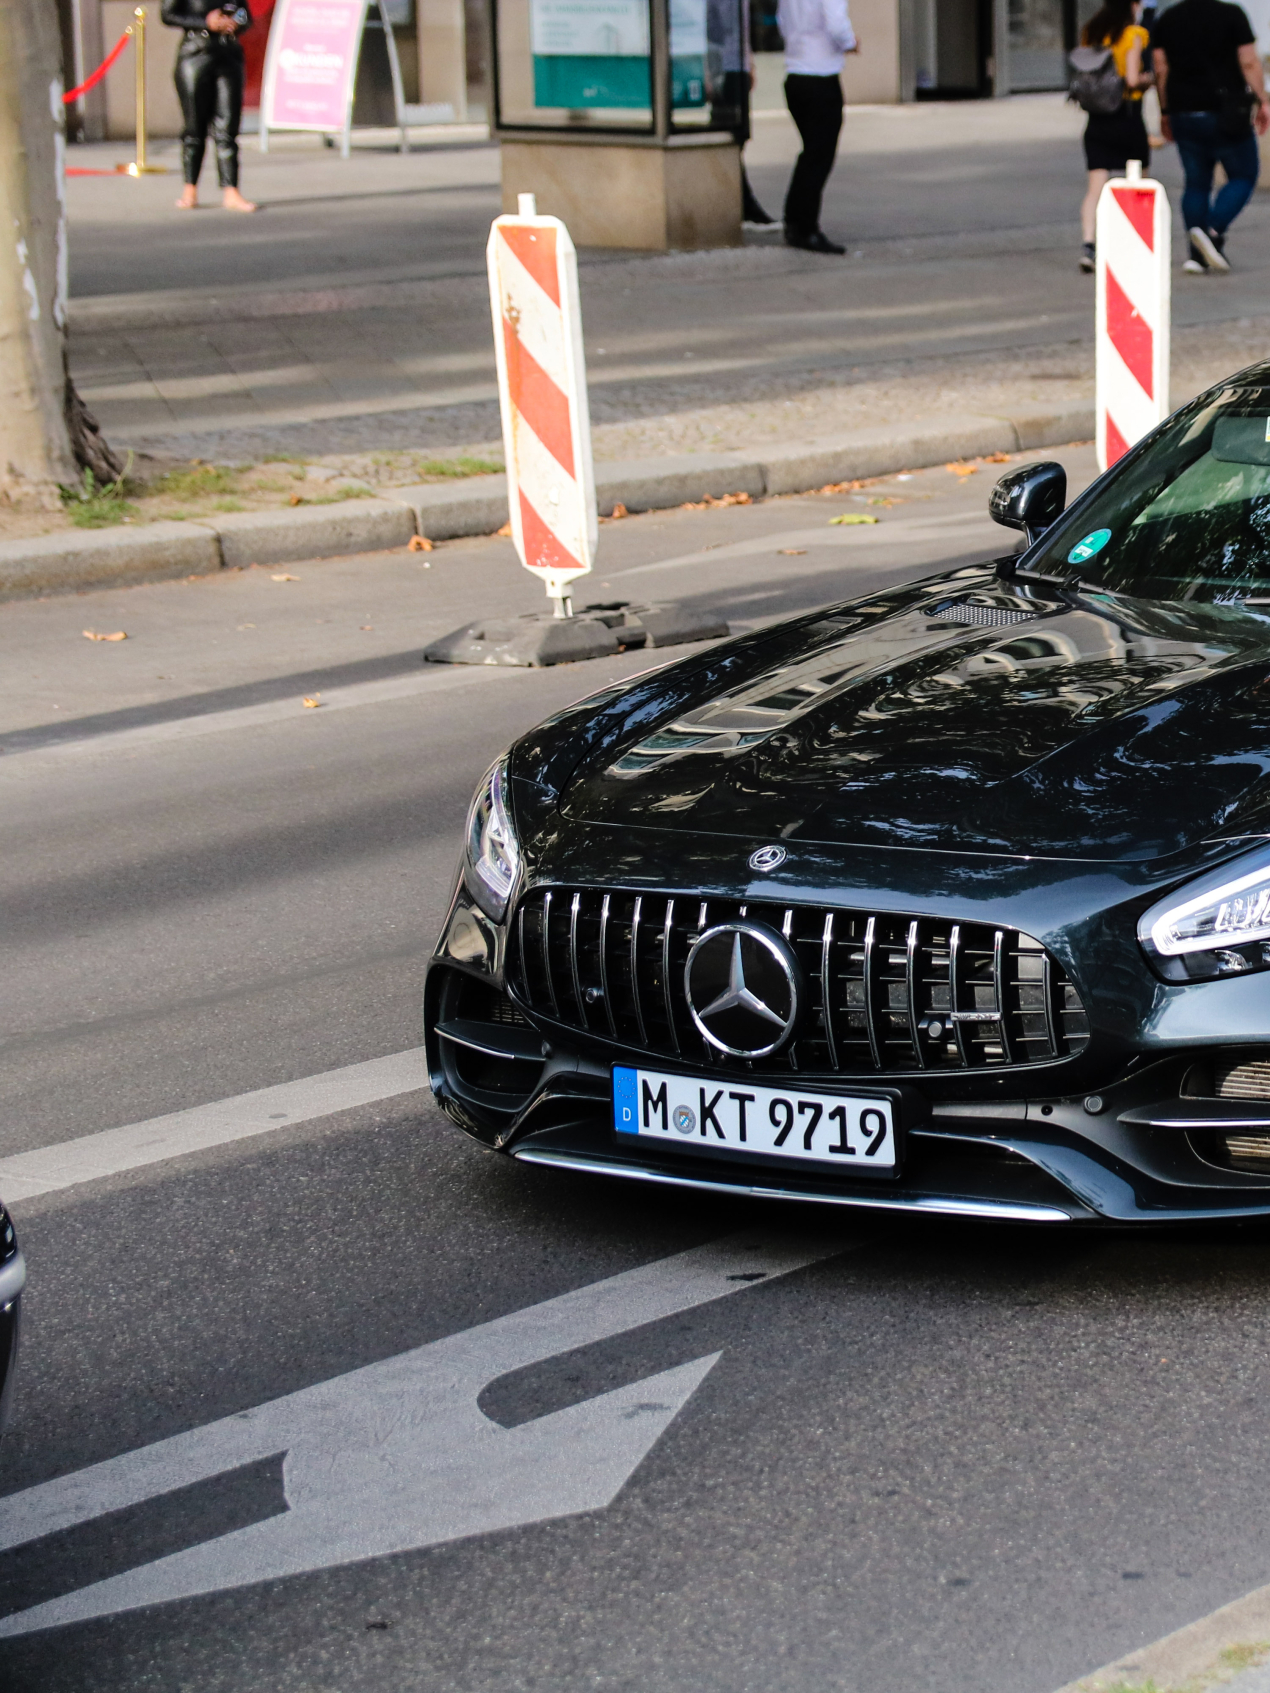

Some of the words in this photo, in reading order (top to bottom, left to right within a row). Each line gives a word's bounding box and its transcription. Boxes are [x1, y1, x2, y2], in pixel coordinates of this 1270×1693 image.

[622, 1106, 632, 1122] D
[641, 1078, 669, 1131] M
[699, 1086, 756, 1142] KT
[768, 1096, 888, 1156] 9719
